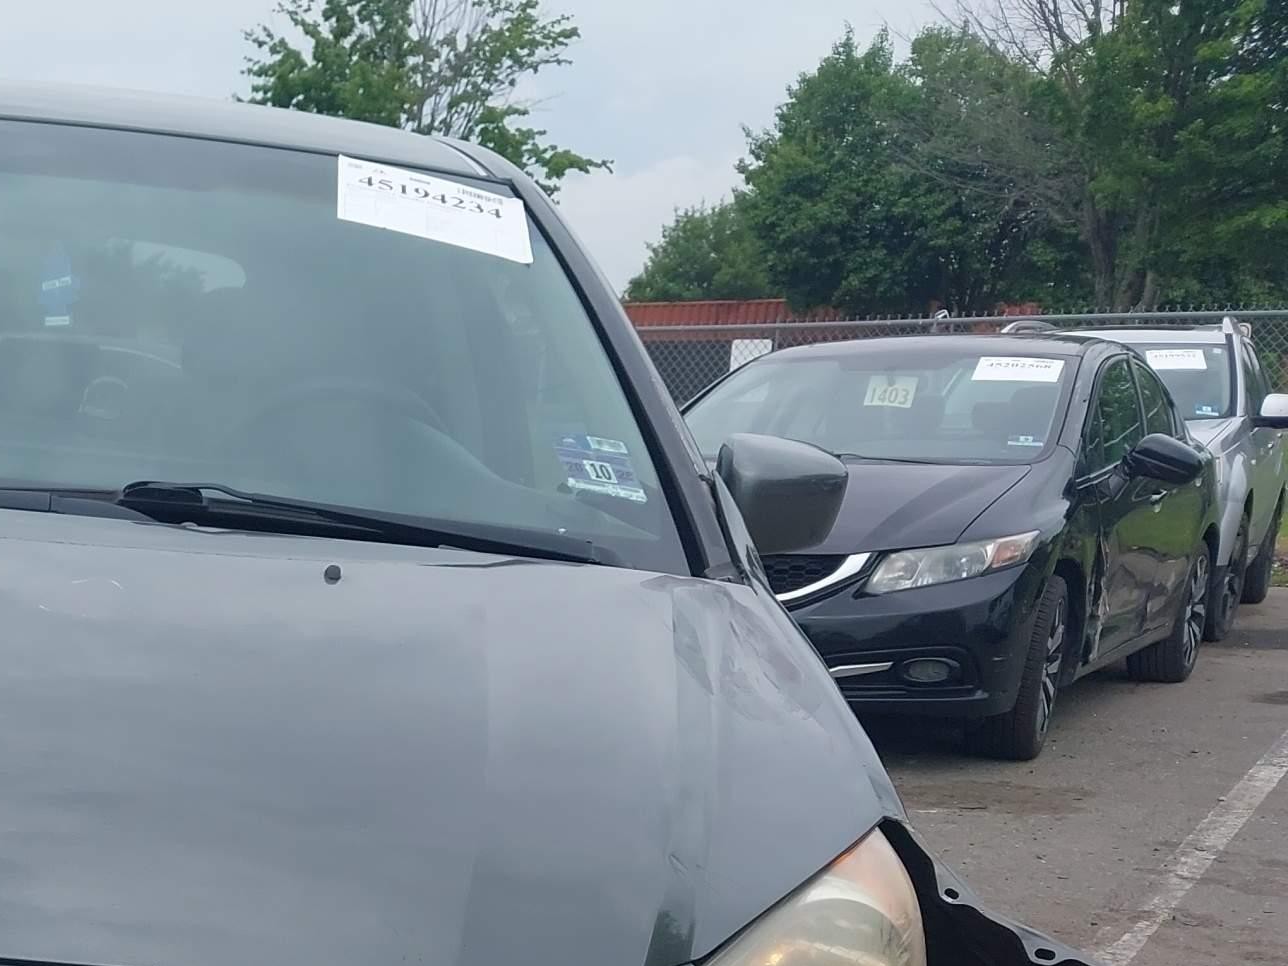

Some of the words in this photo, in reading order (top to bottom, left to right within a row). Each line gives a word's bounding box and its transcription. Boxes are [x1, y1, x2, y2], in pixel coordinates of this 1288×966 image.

[358, 176, 503, 219] 45194234
[870, 386, 910, 405] 1403
[589, 463, 611, 480] 10
